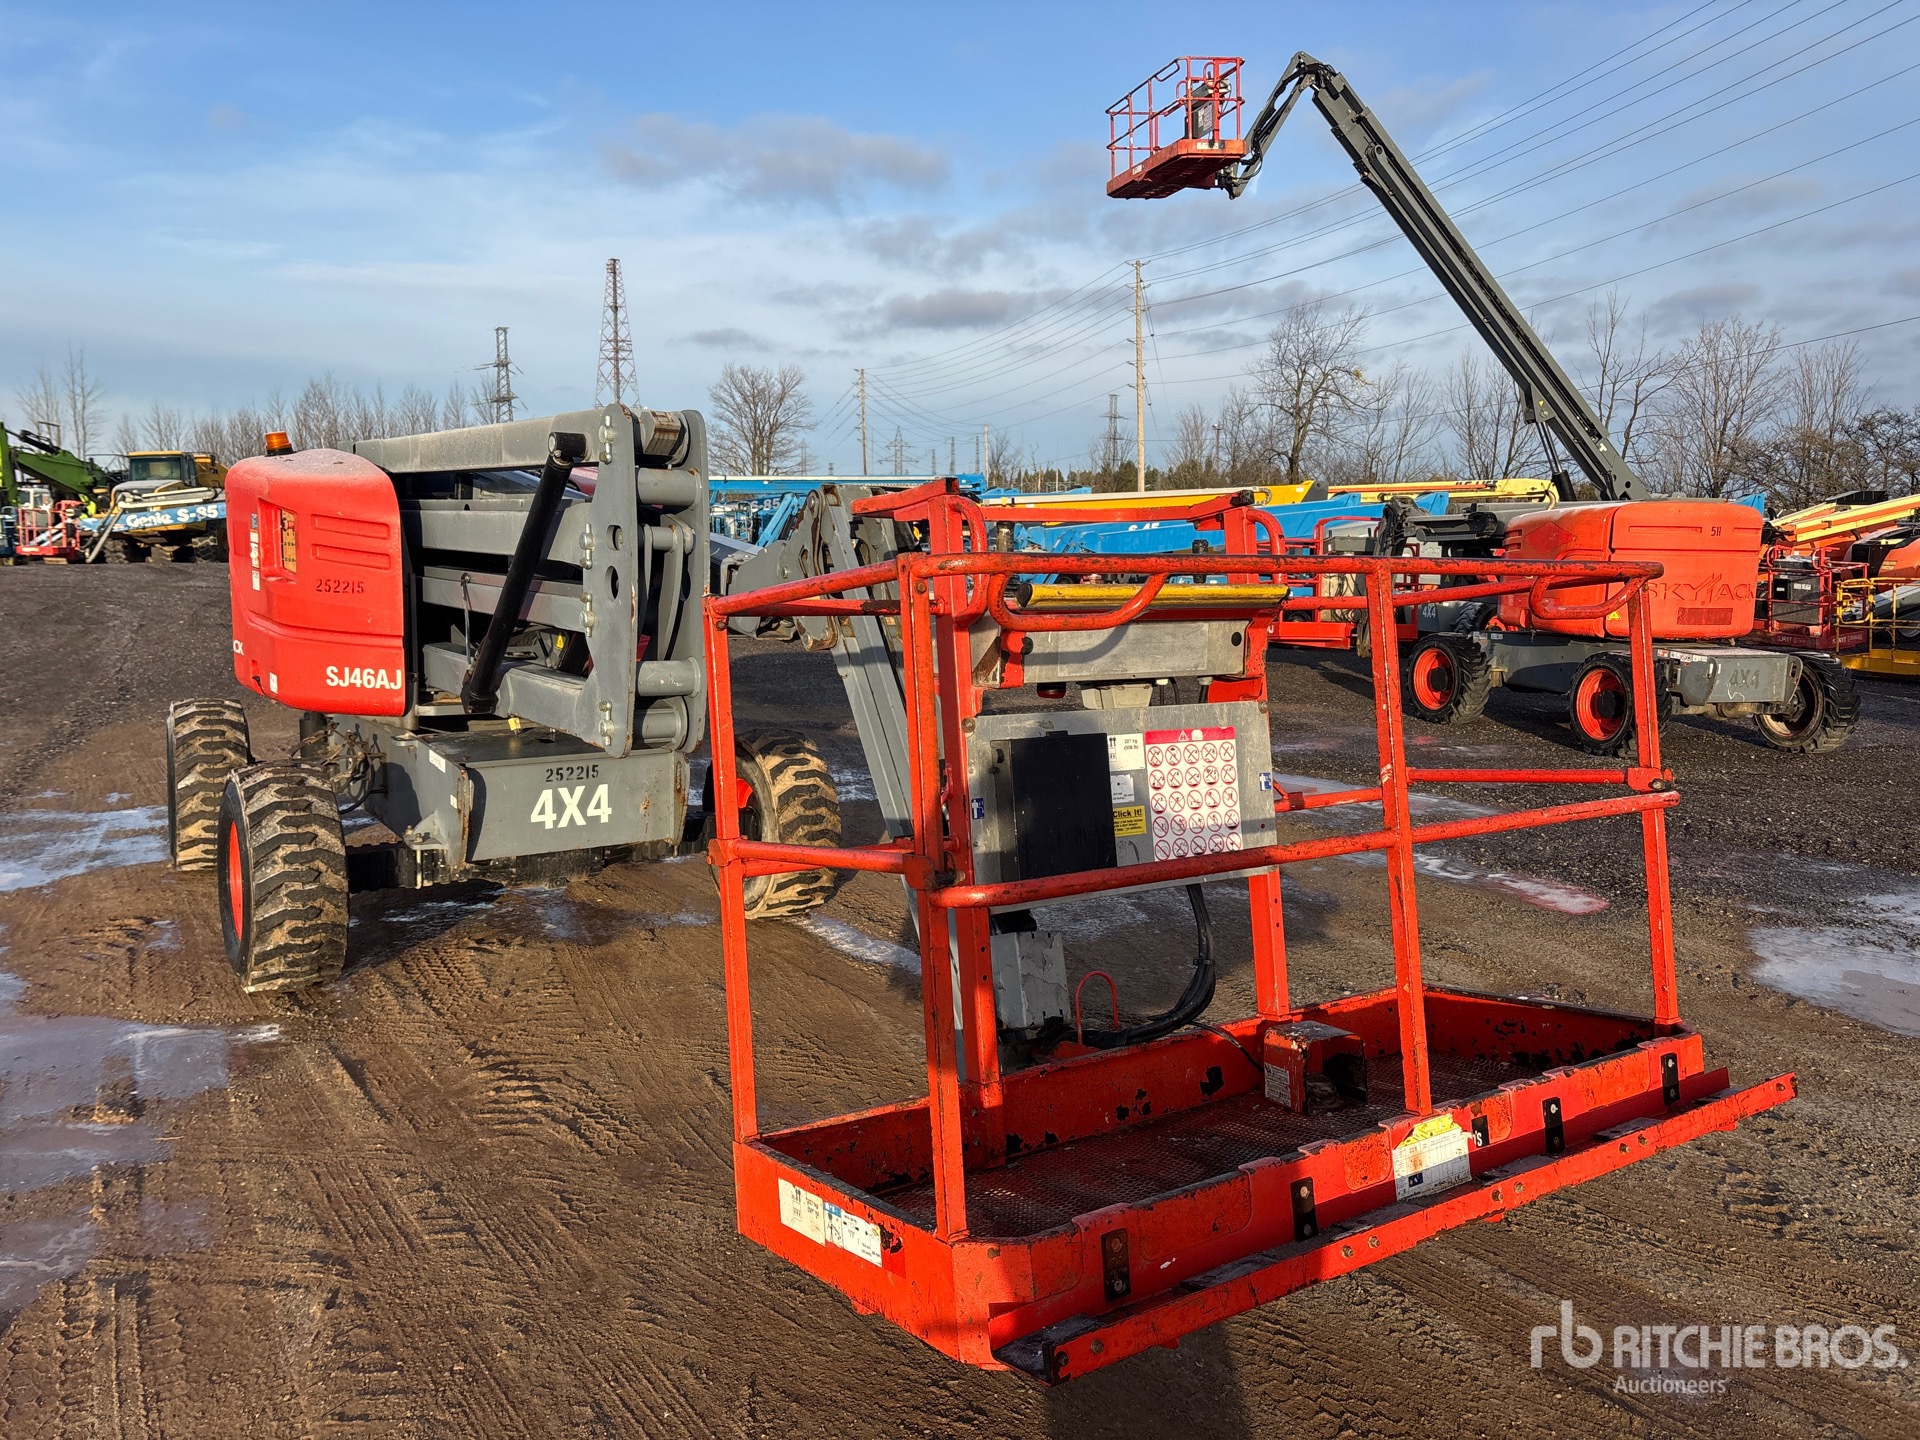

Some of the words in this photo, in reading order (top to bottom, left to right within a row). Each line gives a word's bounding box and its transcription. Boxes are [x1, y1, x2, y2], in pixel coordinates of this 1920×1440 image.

[126, 512, 174, 527] Genie
[177, 505, 218, 522] S-85
[315, 579, 365, 594] 252215
[326, 665, 402, 690] SJ46AJ
[545, 765, 600, 782] 252215
[530, 783, 613, 830] 4X4
[1113, 810, 1132, 818] Click
